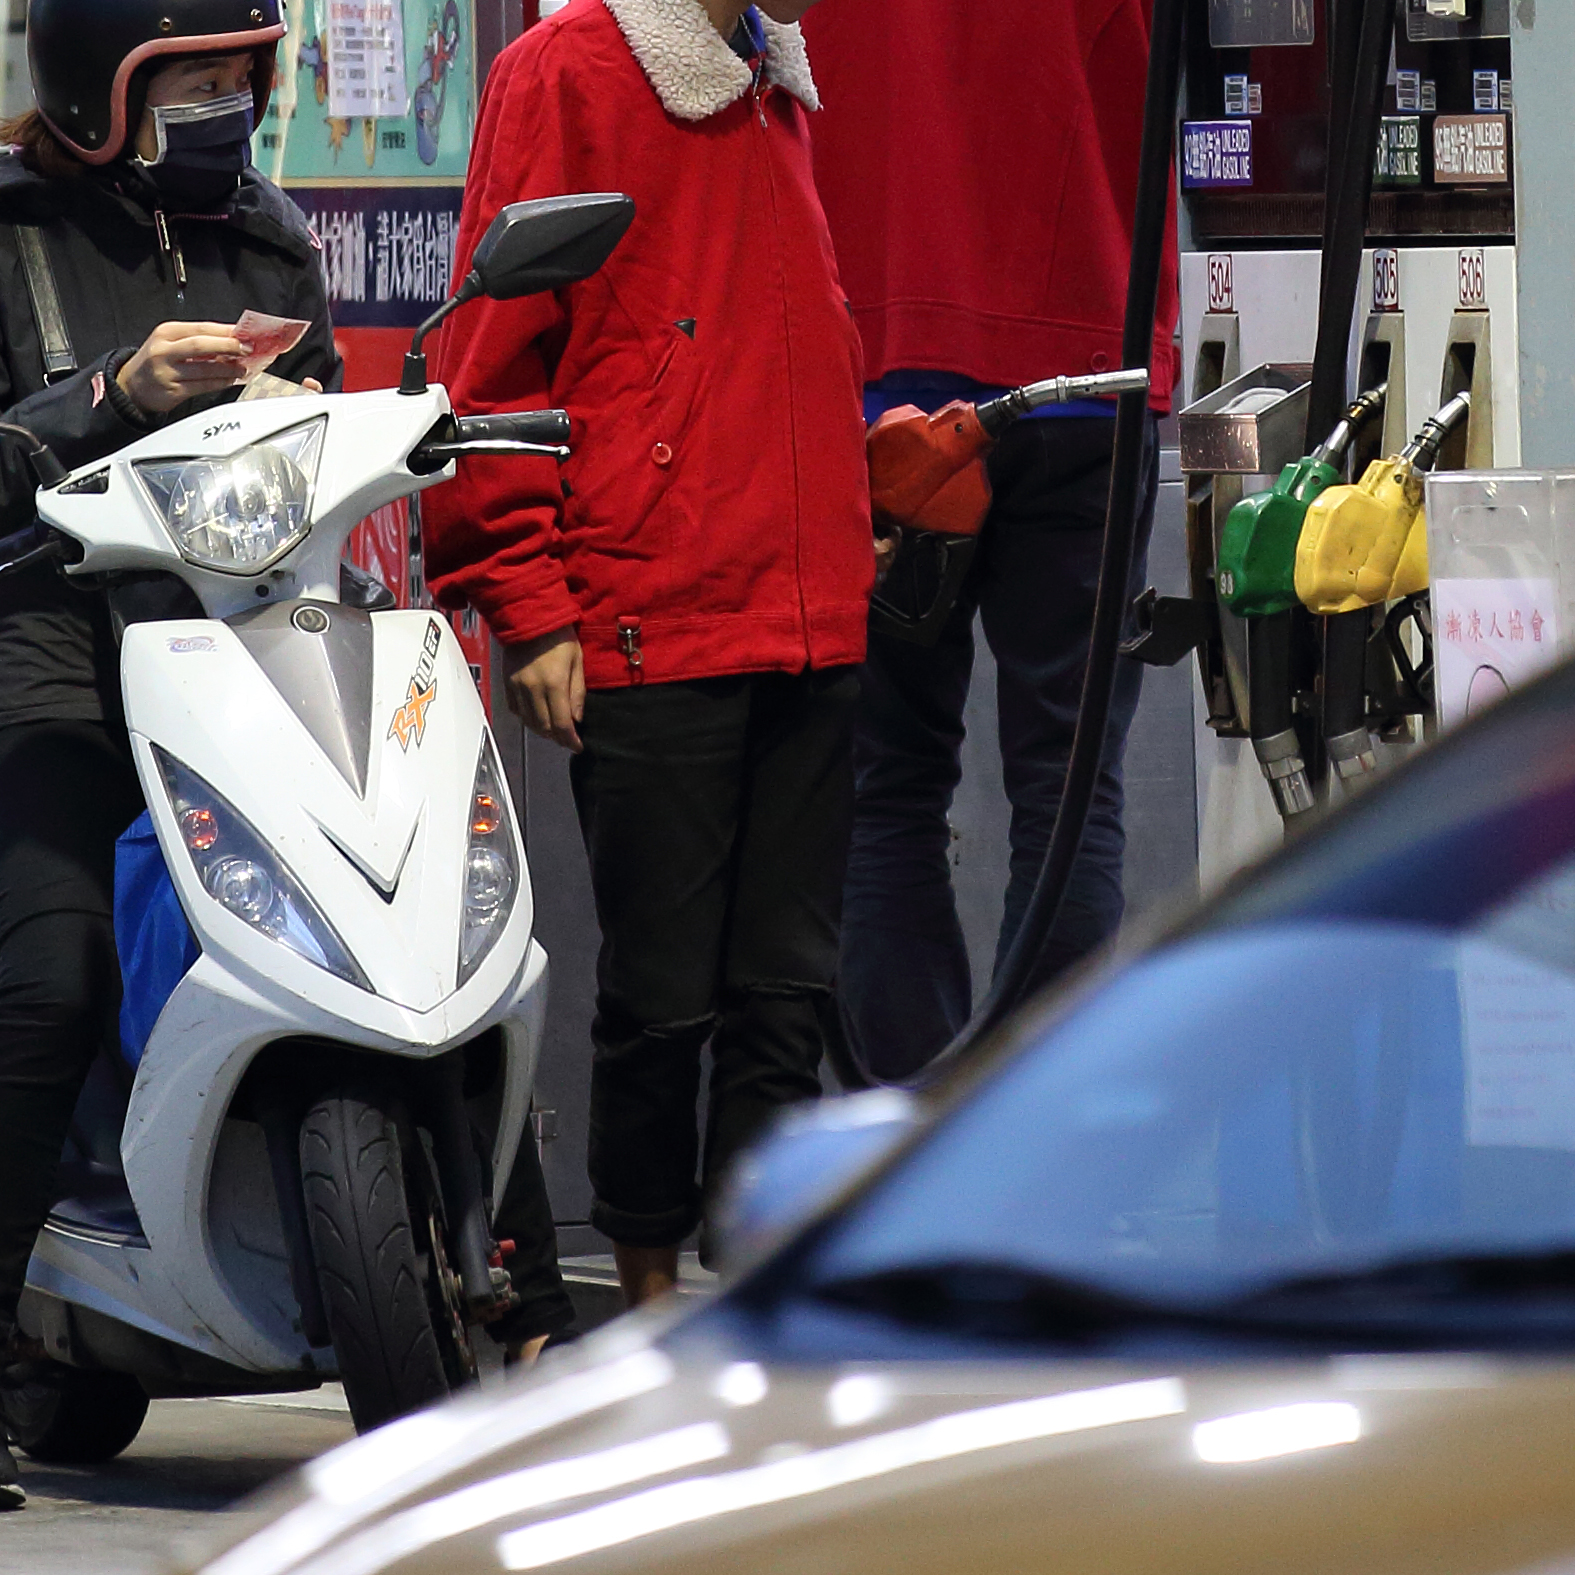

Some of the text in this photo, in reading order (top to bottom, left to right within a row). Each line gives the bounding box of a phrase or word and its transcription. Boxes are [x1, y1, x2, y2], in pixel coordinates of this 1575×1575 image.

[1209, 257, 1232, 308] 504
[1375, 252, 1397, 306] 505
[1460, 252, 1484, 303] 506
[201, 420, 242, 440] SYM
[1219, 572, 1234, 595] 98
[1445, 609, 1546, 643] 漸凍人協會
